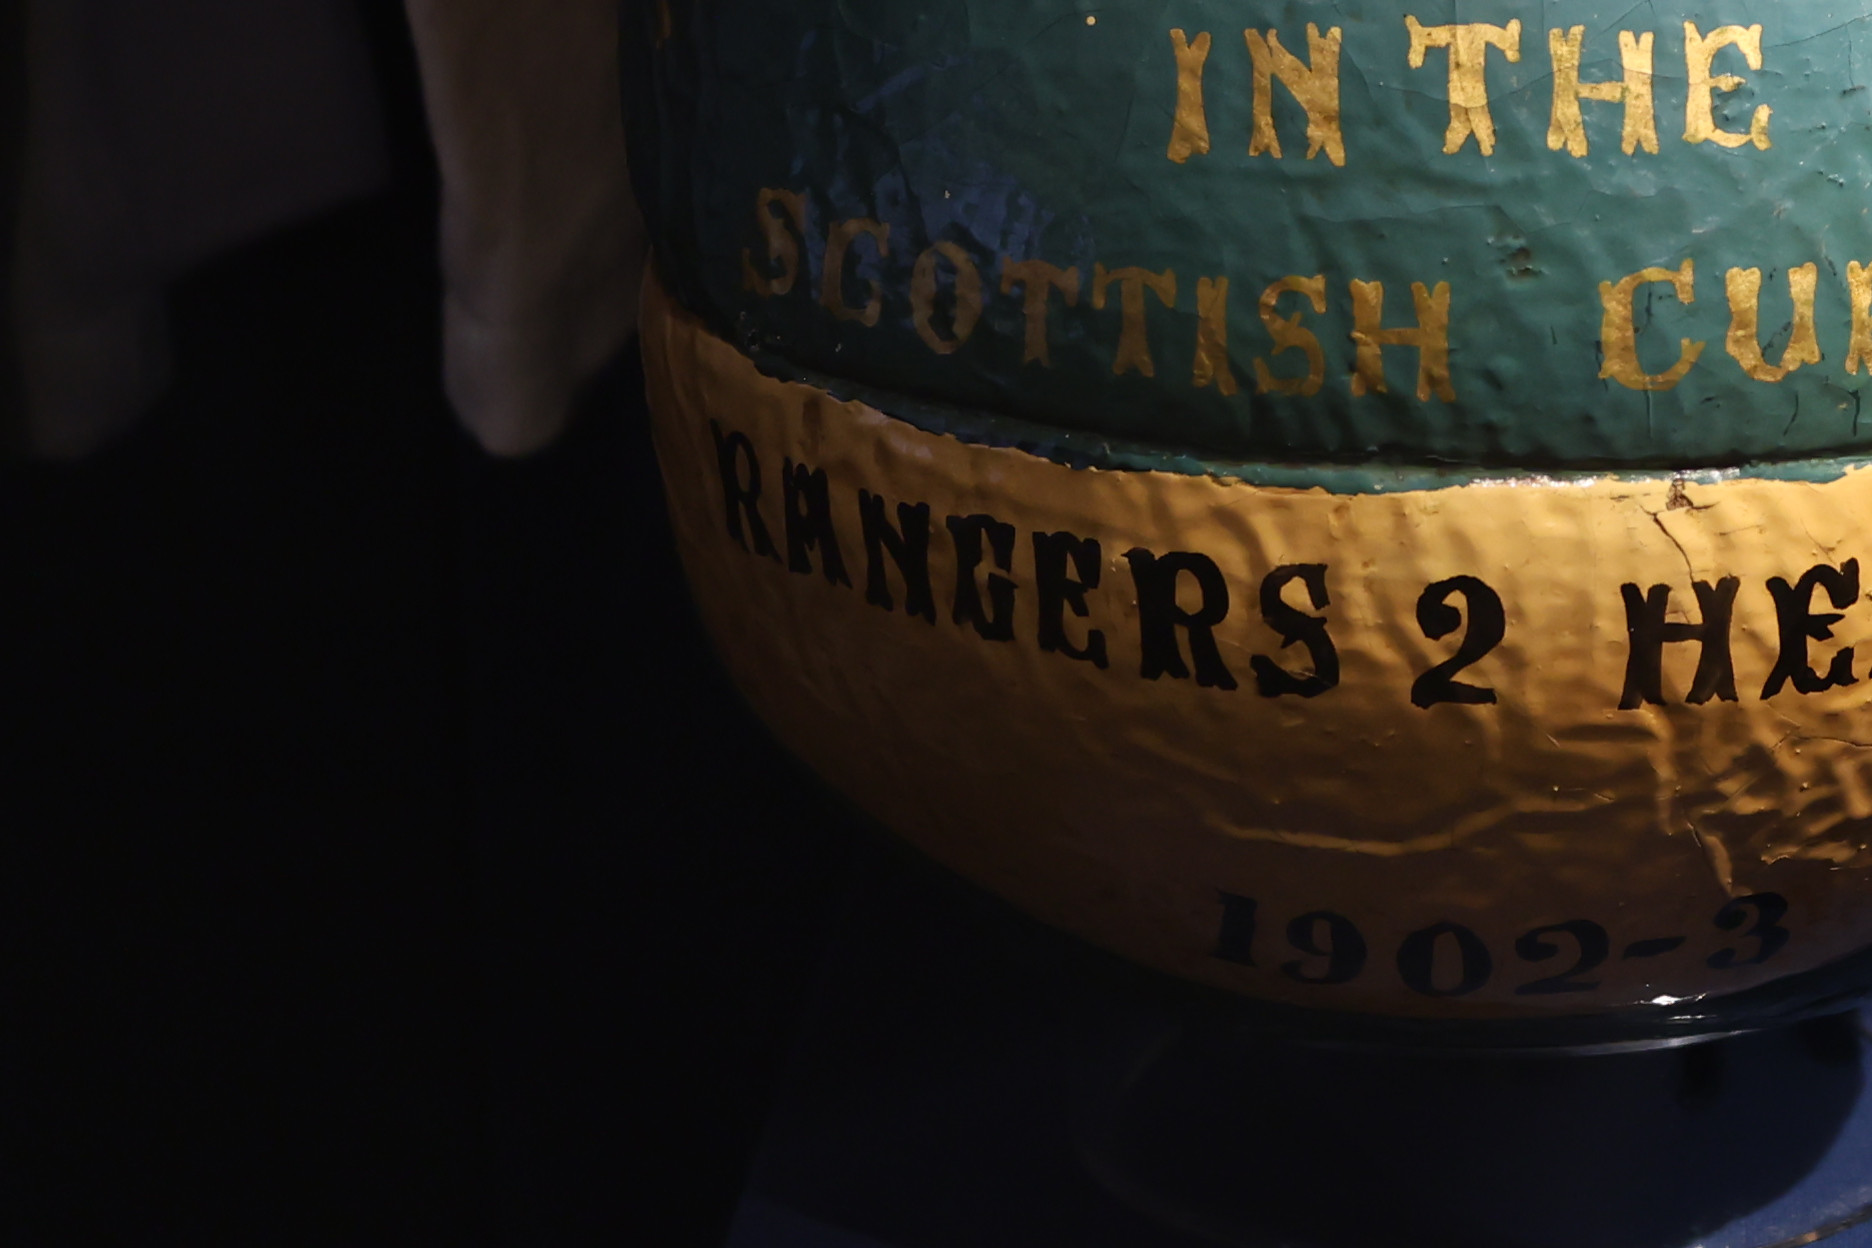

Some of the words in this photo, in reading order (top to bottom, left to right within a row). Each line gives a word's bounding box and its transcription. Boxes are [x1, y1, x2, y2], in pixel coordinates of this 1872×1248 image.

[1166, 21, 1346, 167] IN
[1403, 12, 1774, 158] THE
[741, 186, 1457, 403] SCOTTISH
[708, 417, 1341, 699] RANGERS
[1409, 574, 1509, 711] 2
[1206, 885, 1792, 998] 1902-3
